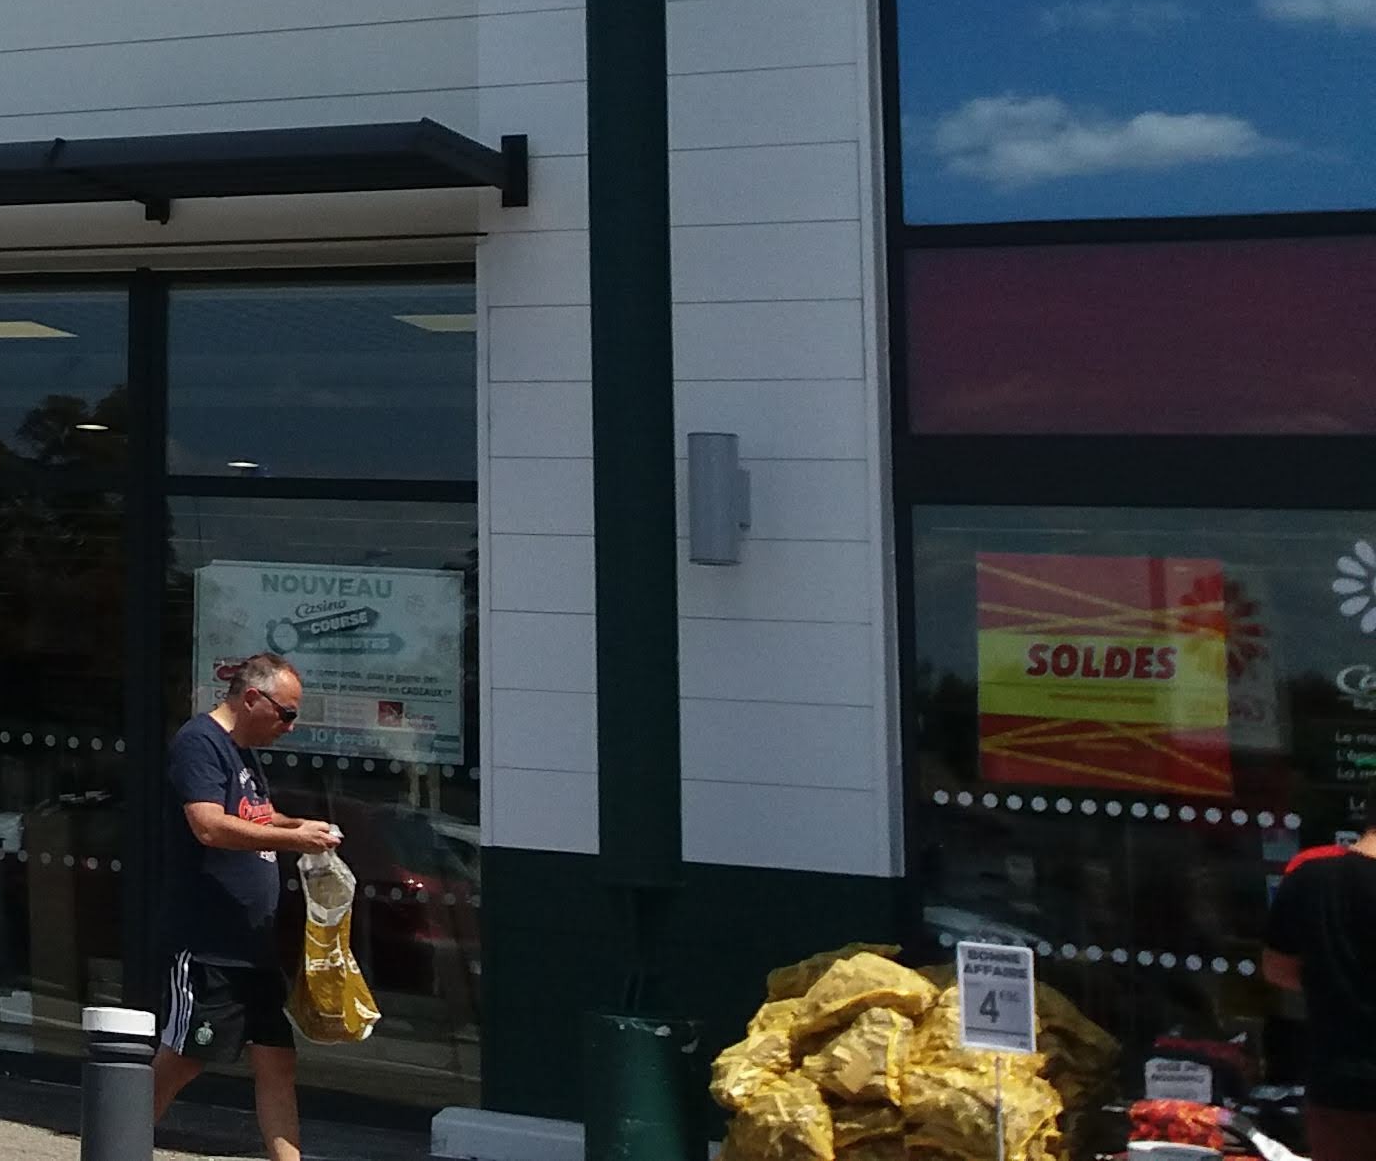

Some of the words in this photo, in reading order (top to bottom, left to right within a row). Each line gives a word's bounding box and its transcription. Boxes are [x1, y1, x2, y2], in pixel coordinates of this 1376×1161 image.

[261, 573, 394, 599] NOUVEAU
[295, 599, 347, 619] Casino
[310, 611, 368, 635] COURSE
[1024, 642, 1178, 680] SOLDES
[963, 963, 1028, 979] AFFAIRE
